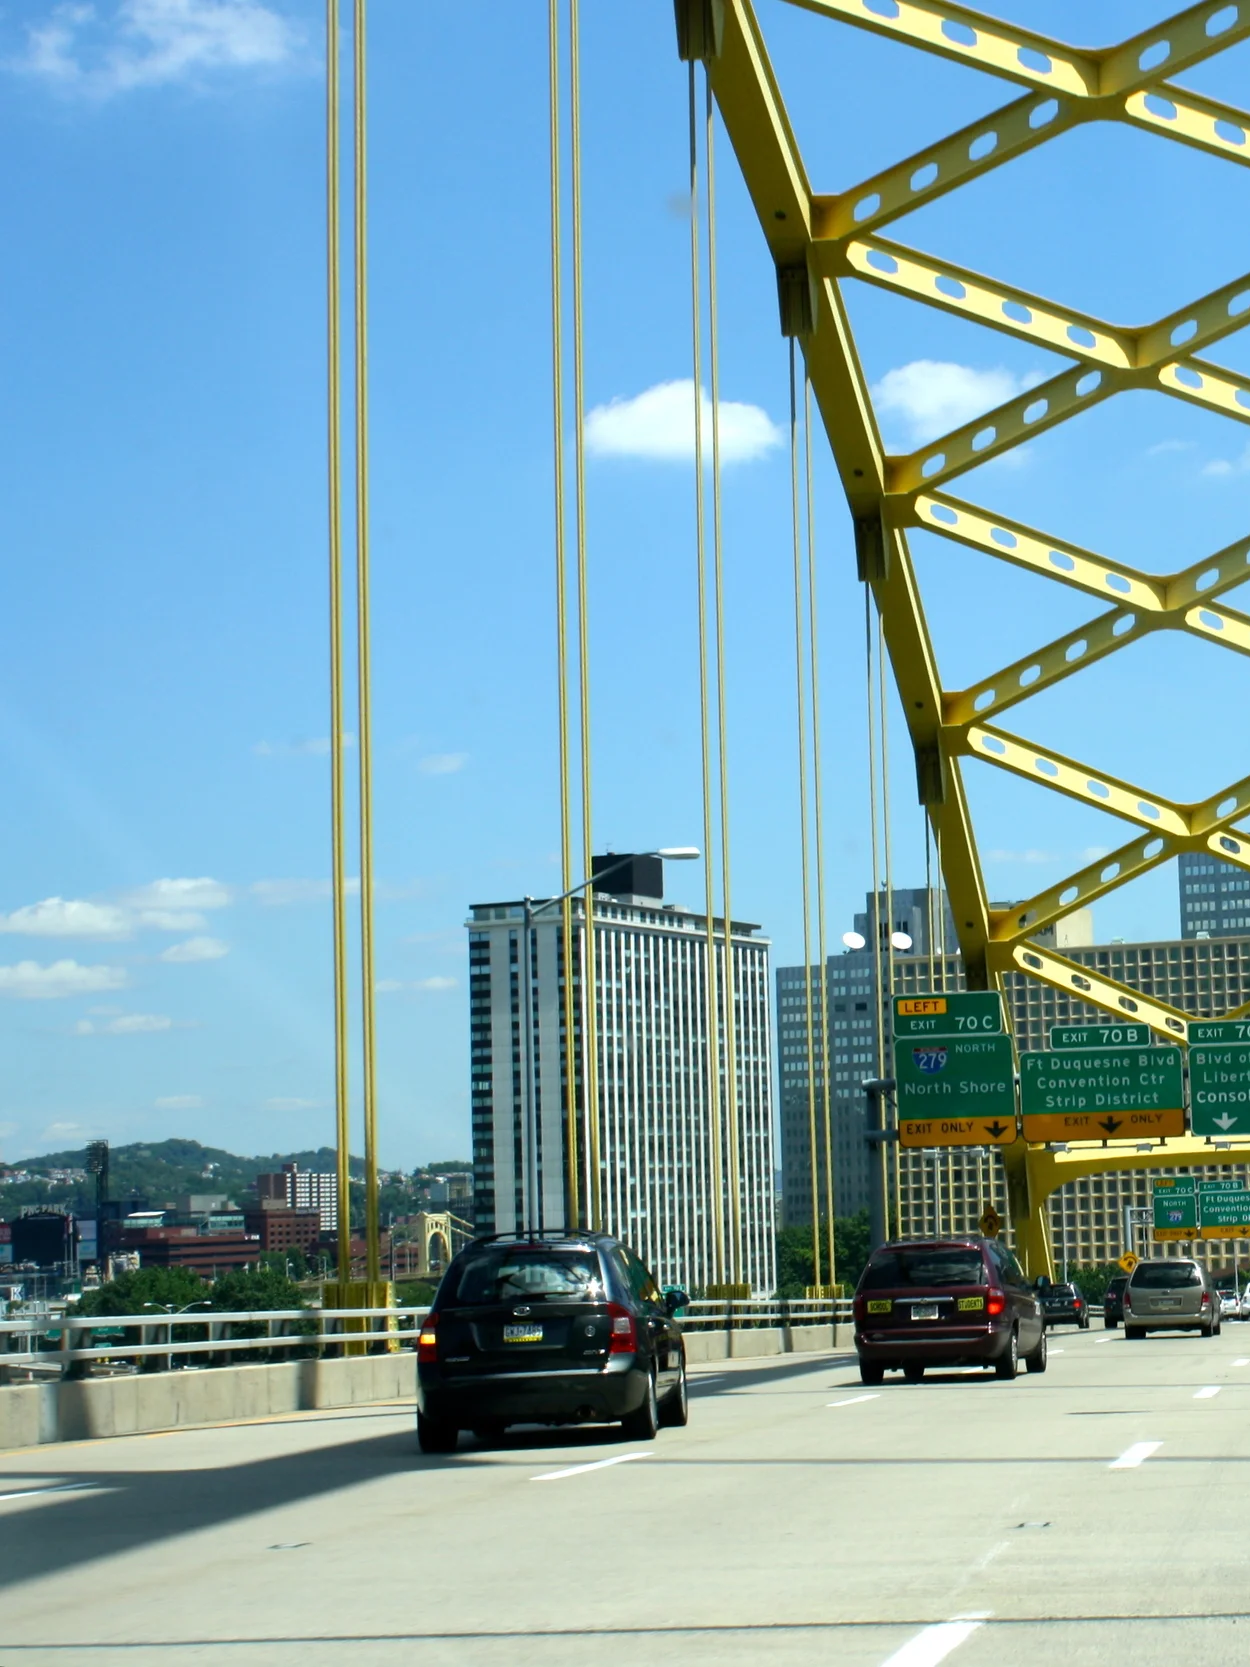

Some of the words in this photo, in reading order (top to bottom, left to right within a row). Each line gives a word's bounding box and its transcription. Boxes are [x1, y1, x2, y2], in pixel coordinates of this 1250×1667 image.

[904, 1000, 939, 1013] LEFT
[910, 1020, 936, 1030] EXIT
[1062, 1033, 1088, 1043] EXIT
[1198, 1028, 1223, 1039] EXIT
[955, 1043, 995, 1054] NORTH
[919, 1052, 947, 1069] 279
[1027, 1059, 1043, 1071] Ft
[1051, 1056, 1130, 1073] Duquesne
[1139, 1054, 1175, 1068] Blvd
[1196, 1051, 1231, 1065] Blvd
[905, 1082, 951, 1095] North
[960, 1080, 1006, 1094] Shore
[1037, 1075, 1131, 1089] Convention
[1139, 1073, 1165, 1085] Ctr
[1045, 1094, 1087, 1108] Strip
[1095, 1092, 1159, 1106] District
[1064, 1116, 1089, 1127] EXIT
[1131, 1114, 1163, 1124] ONLY
[907, 1123, 932, 1134] EXIT
[941, 1122, 973, 1134] ONLY
[21, 1205, 39, 1219] PNC
[42, 1204, 67, 1216] PARK
[1218, 1215, 1237, 1223] Strip
